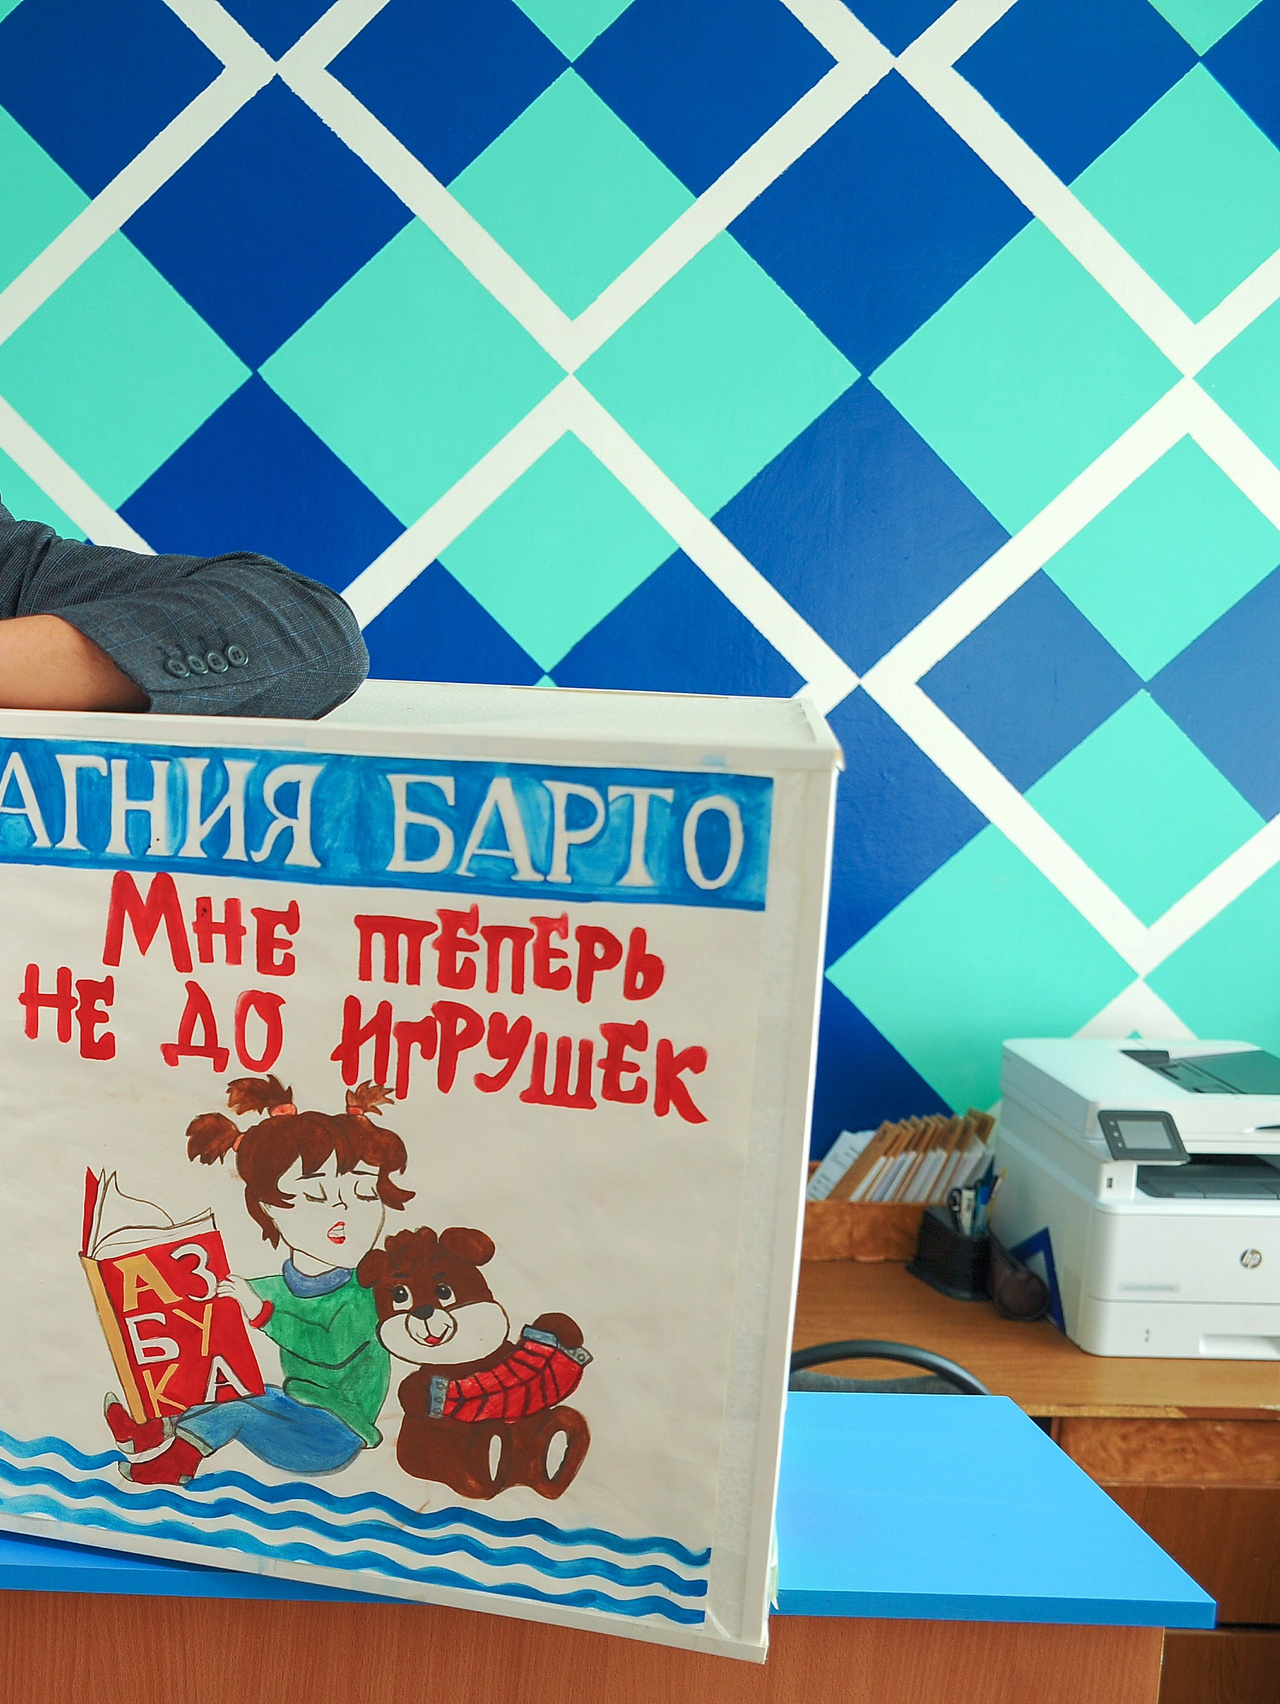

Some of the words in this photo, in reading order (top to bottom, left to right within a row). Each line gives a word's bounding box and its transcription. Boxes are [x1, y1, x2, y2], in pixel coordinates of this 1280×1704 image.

[386, 773, 745, 891] БАРТО
[18, 963, 116, 1061] НЕ
[160, 980, 287, 1073] ДО
